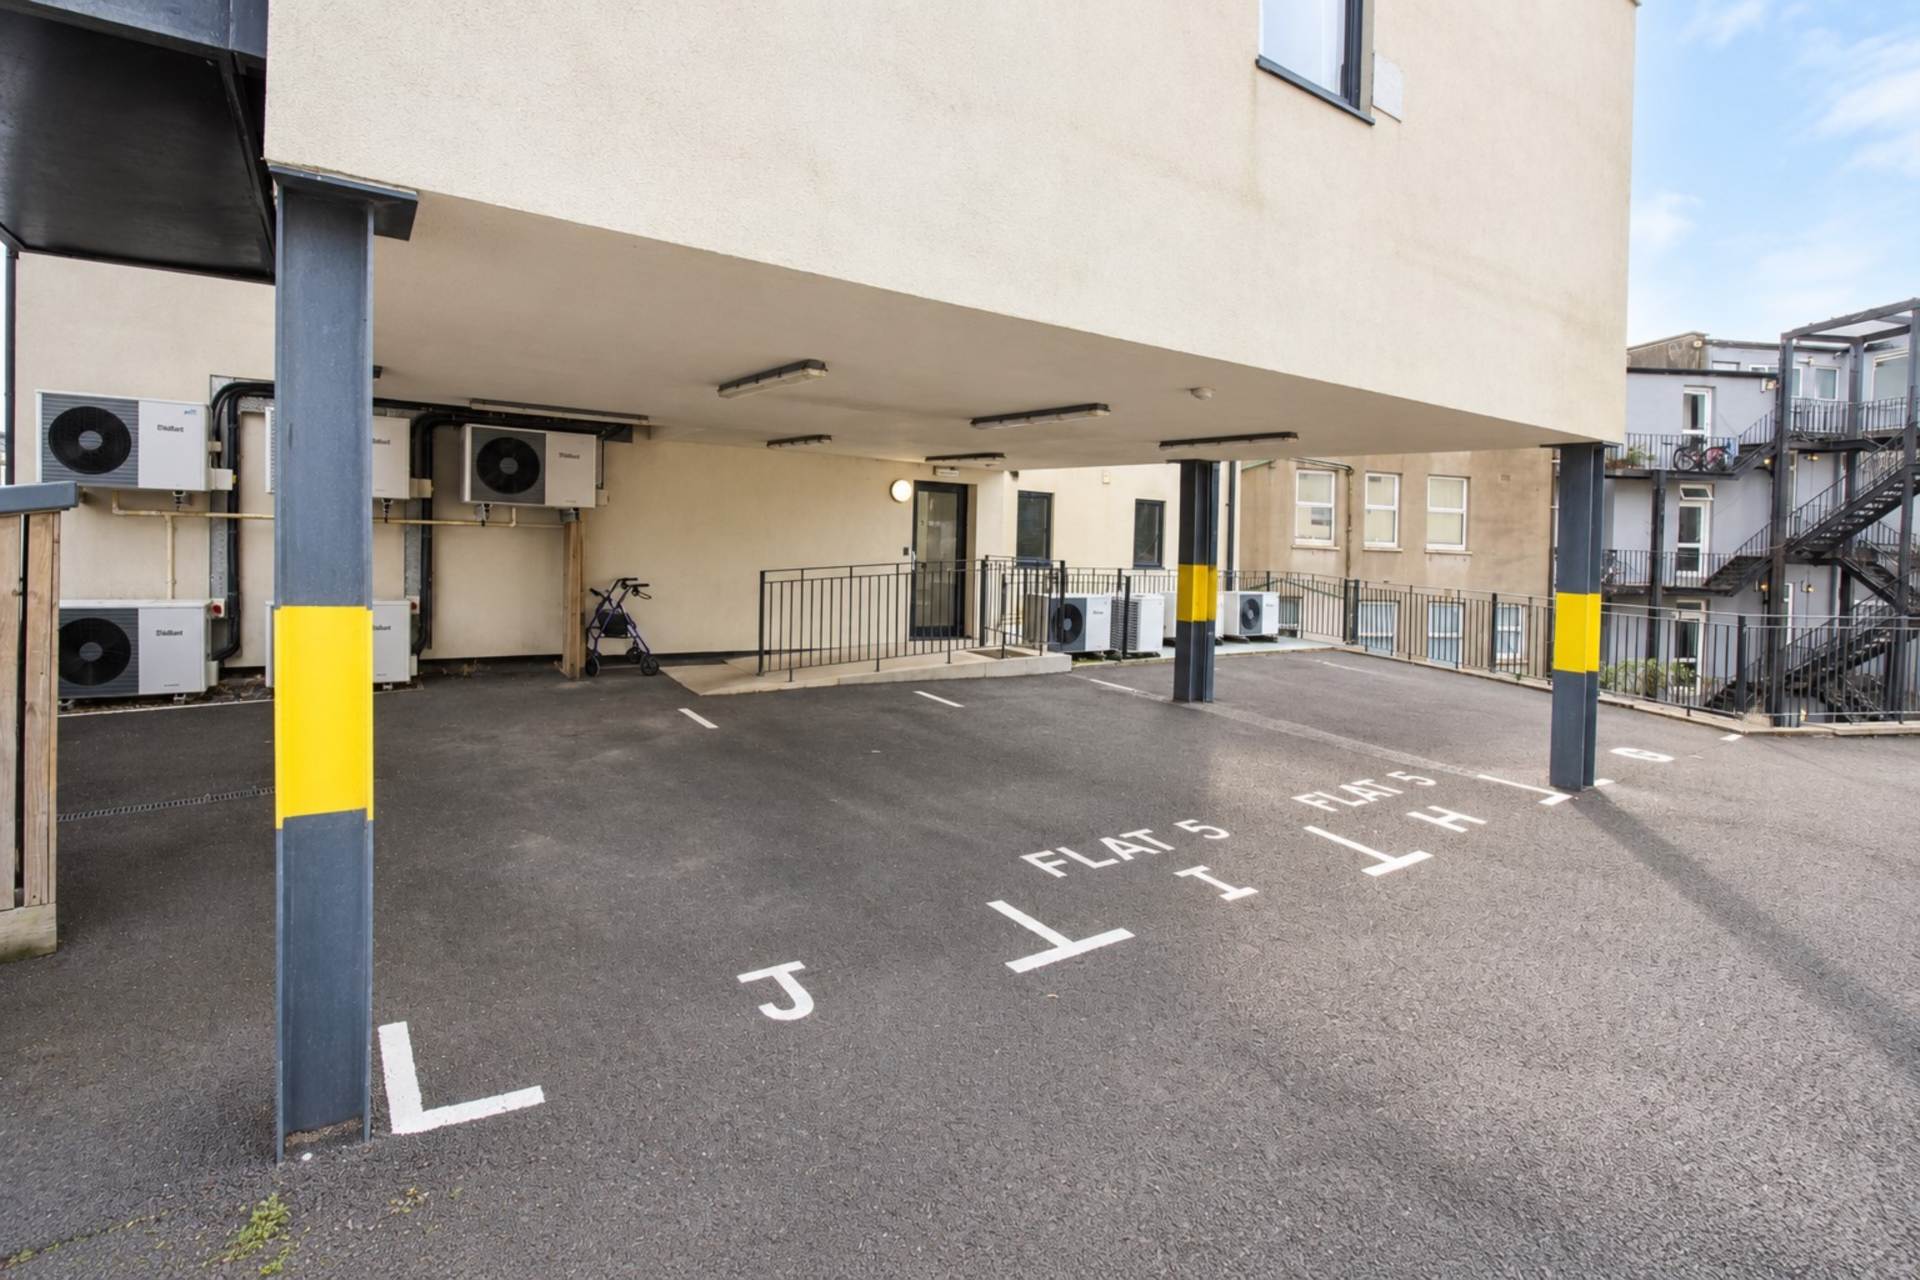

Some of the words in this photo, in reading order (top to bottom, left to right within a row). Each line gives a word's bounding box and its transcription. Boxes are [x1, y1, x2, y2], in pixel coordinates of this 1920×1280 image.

[1291, 779, 1403, 812] FLAT
[1386, 771, 1436, 786] 5
[1406, 805, 1487, 833] H
[1020, 828, 1175, 878] FLAT
[1174, 819, 1230, 840] 5
[1174, 864, 1259, 901] I
[737, 961, 815, 1021] J
